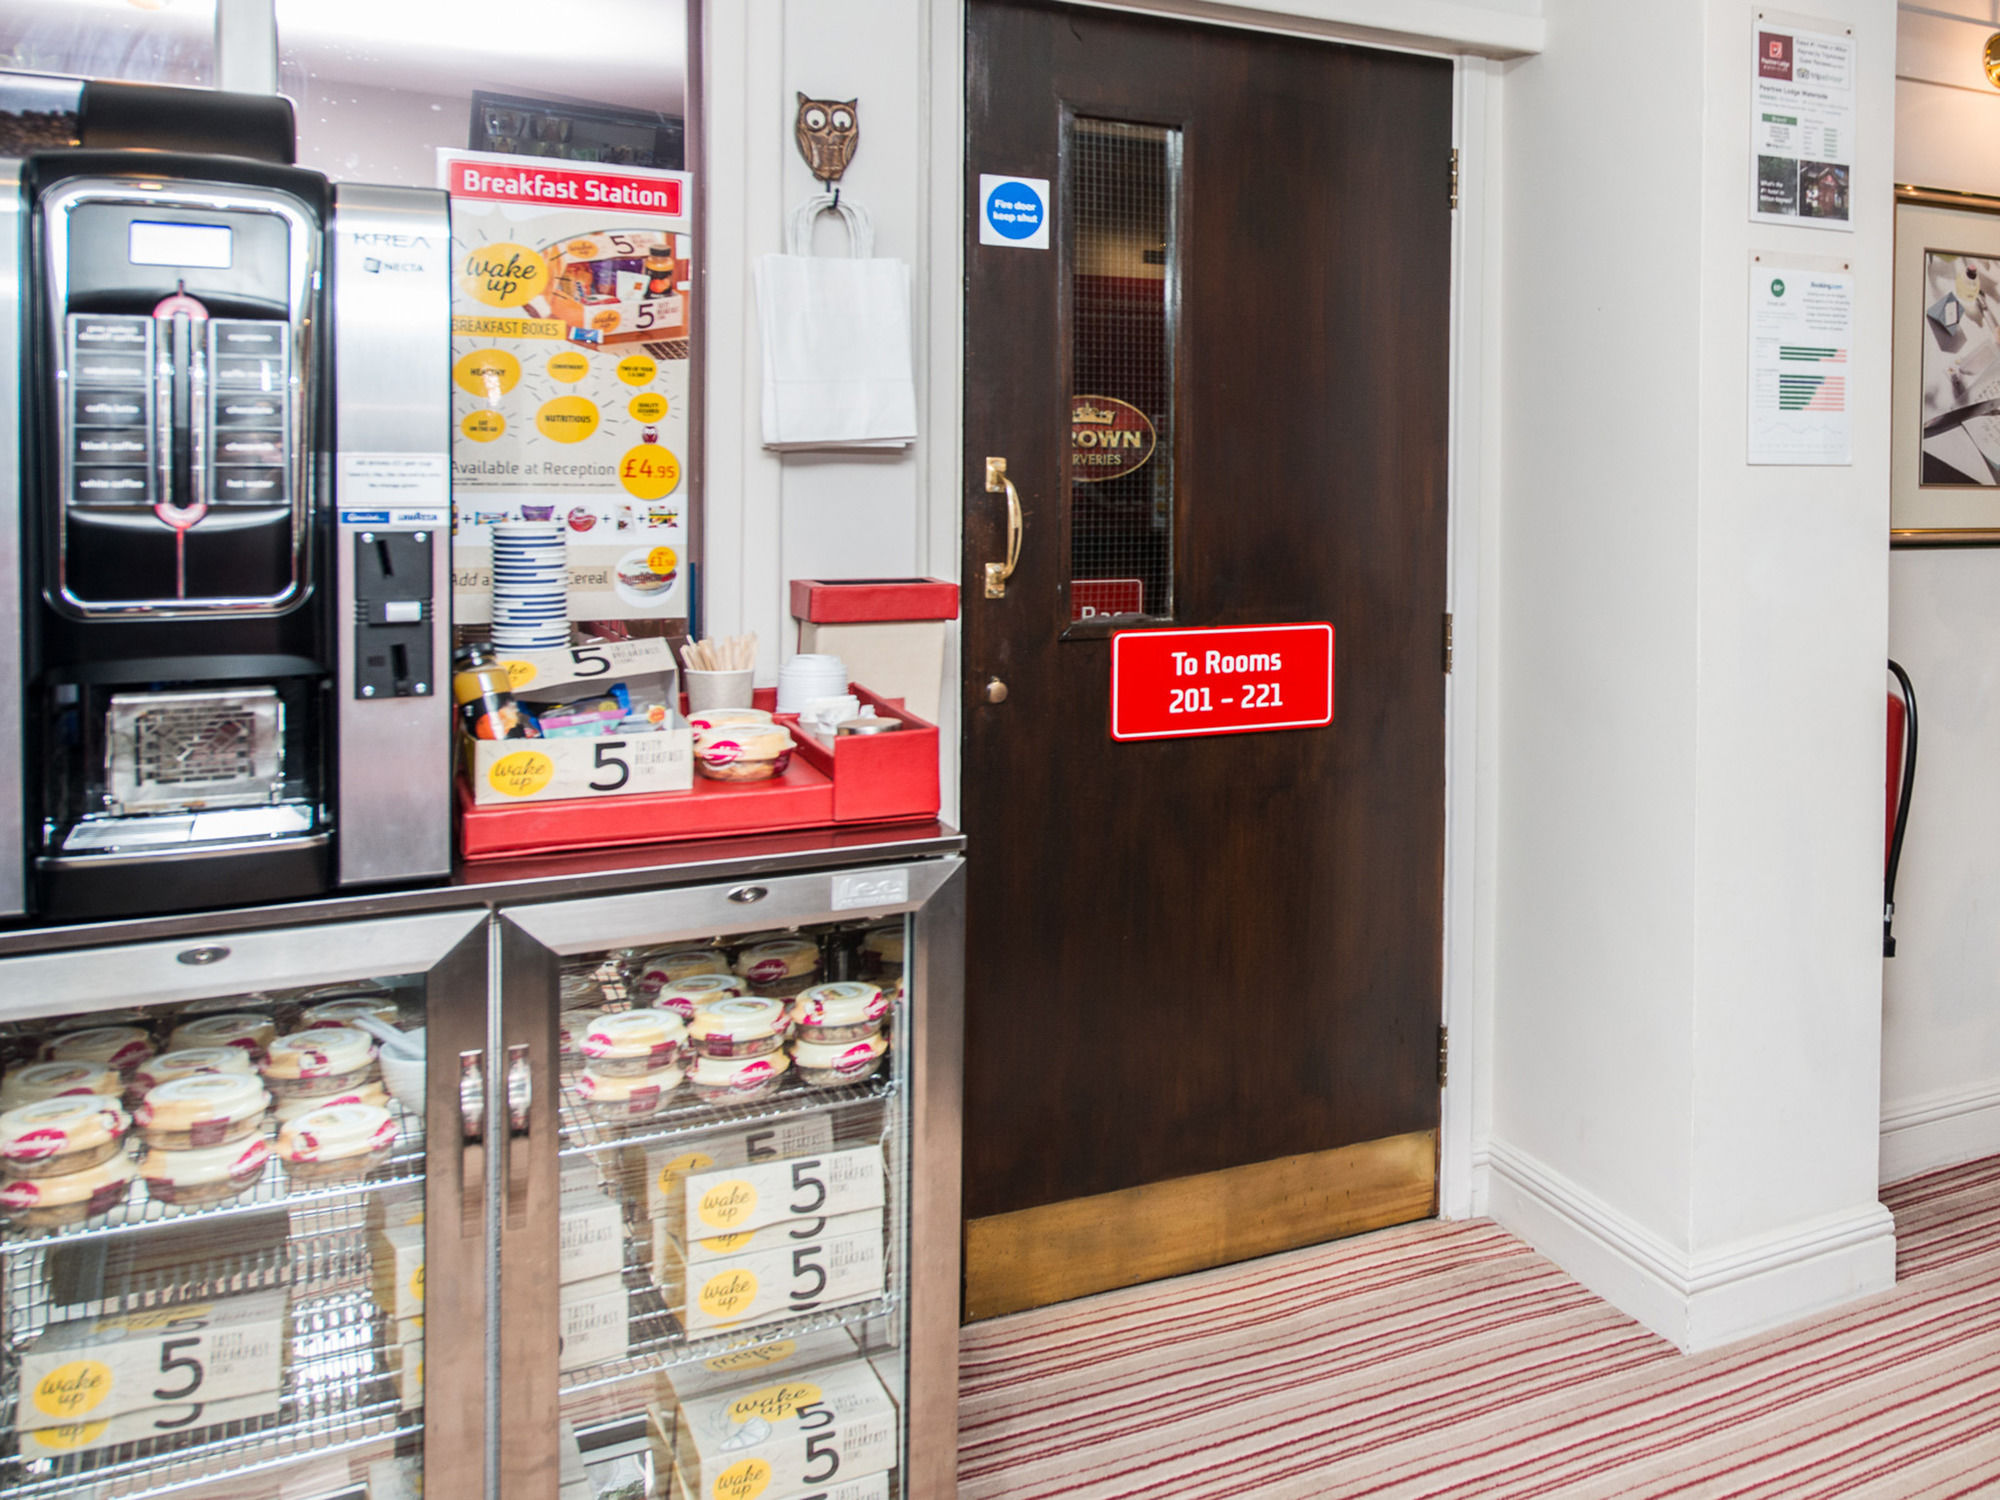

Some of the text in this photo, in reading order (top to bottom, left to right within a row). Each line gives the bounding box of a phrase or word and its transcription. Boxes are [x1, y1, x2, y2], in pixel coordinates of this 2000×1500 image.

[463, 169, 668, 207] Breakfast Station
[995, 199, 1036, 211] Fire door
[993, 210, 1038, 223] keep shut
[610, 235, 635, 255] 5
[384, 263, 424, 272] NECTA
[466, 253, 537, 280] wake
[488, 279, 517, 301] up
[635, 303, 654, 329] 5
[452, 319, 559, 336] BREAKFAST BOXES
[545, 415, 591, 424] NUTRITIOUS
[452, 459, 519, 476] Available
[525, 462, 538, 476] at
[543, 462, 616, 479] Reception
[624, 458, 676, 479] £4.95
[452, 572, 478, 587] Add
[482, 576, 489, 586] a
[508, 664, 527, 675] ke
[570, 647, 611, 677] 5
[1171, 650, 1282, 676] To Rooms
[1169, 687, 1213, 714] 201
[1241, 682, 1283, 709] 221
[494, 757, 546, 777] wake
[589, 741, 630, 791] 5
[509, 777, 531, 791] up
[829, 1163, 874, 1183] BREAKFAST
[790, 1159, 826, 1214] 5
[703, 1185, 751, 1210] wake
[717, 1207, 738, 1223] up
[829, 1247, 875, 1268] BREAKFAST
[789, 1246, 826, 1301] 5
[704, 1275, 751, 1300] wake
[717, 1295, 738, 1311] up
[153, 1337, 203, 1400] 5
[41, 1368, 103, 1395] wake
[58, 1393, 85, 1410] up
[735, 1387, 809, 1413] wake
[760, 1403, 792, 1416] up
[795, 1401, 835, 1430] 5
[843, 1430, 888, 1451] BREAKFAST
[802, 1431, 840, 1484] 5
[717, 1464, 764, 1491] wake
[731, 1484, 752, 1500] up
